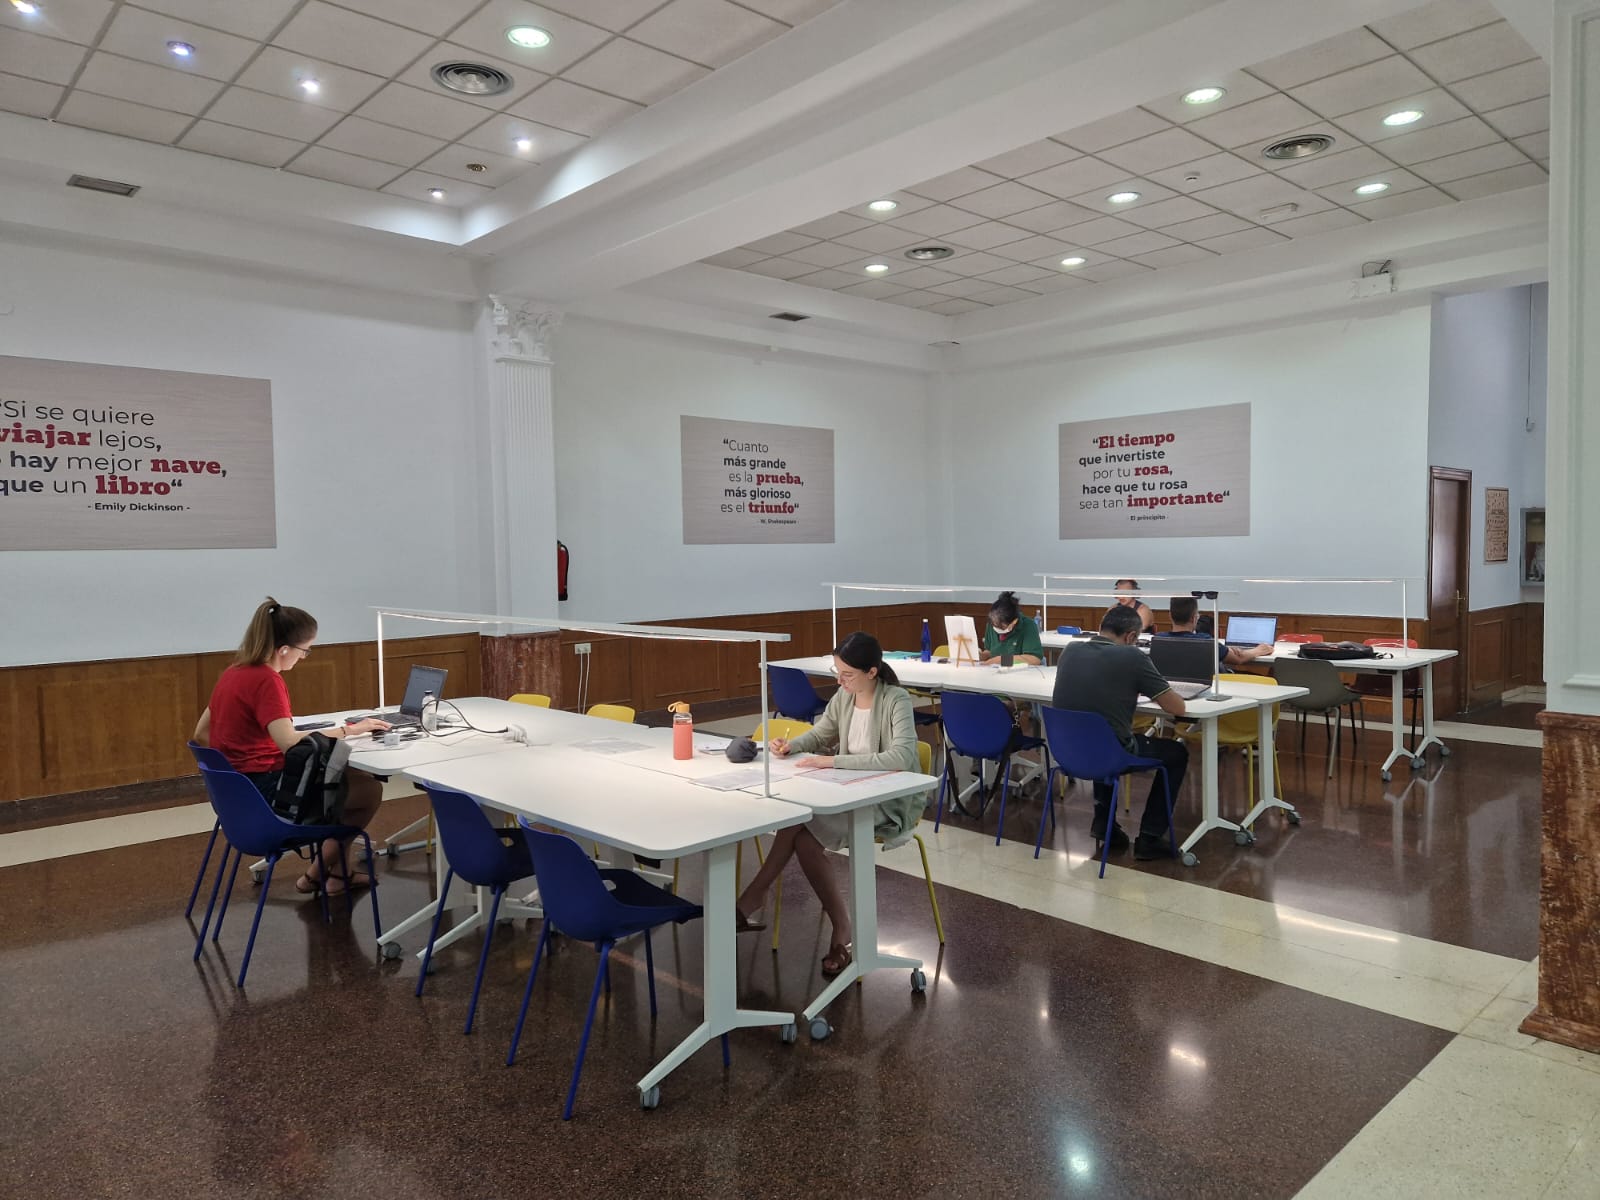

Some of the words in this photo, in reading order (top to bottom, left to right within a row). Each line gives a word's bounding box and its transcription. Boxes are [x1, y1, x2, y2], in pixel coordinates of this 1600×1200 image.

[36, 406, 64, 420] se
[73, 406, 154, 426] quiere
[0, 422, 91, 448] viajar
[100, 429, 161, 452] lejos,
[1117, 433, 1175, 447] tiempo
[10, 451, 58, 472] hay
[68, 454, 142, 474] mejor
[151, 459, 226, 477] nave,
[724, 456, 746, 467] más
[749, 458, 786, 470] grande
[1079, 457, 1102, 467] que
[1105, 449, 1165, 464] invertiste
[729, 473, 741, 482] es
[745, 471, 752, 482] la
[756, 472, 804, 486] prueba,
[1093, 470, 1114, 481] por
[1117, 468, 1130, 478] tu
[1135, 465, 1172, 476] rosa,
[54, 481, 86, 493] un
[725, 487, 747, 497] más
[750, 488, 791, 500] glorioso
[1083, 484, 1111, 494] hace
[1115, 484, 1138, 495] que
[1142, 481, 1155, 491] tu
[1160, 481, 1187, 490] rosa
[95, 502, 126, 512] Emily
[130, 503, 183, 511] Dickinson
[721, 504, 733, 512] es
[736, 502, 745, 512] el
[1080, 501, 1099, 509] sea
[1103, 499, 1123, 508] tan
